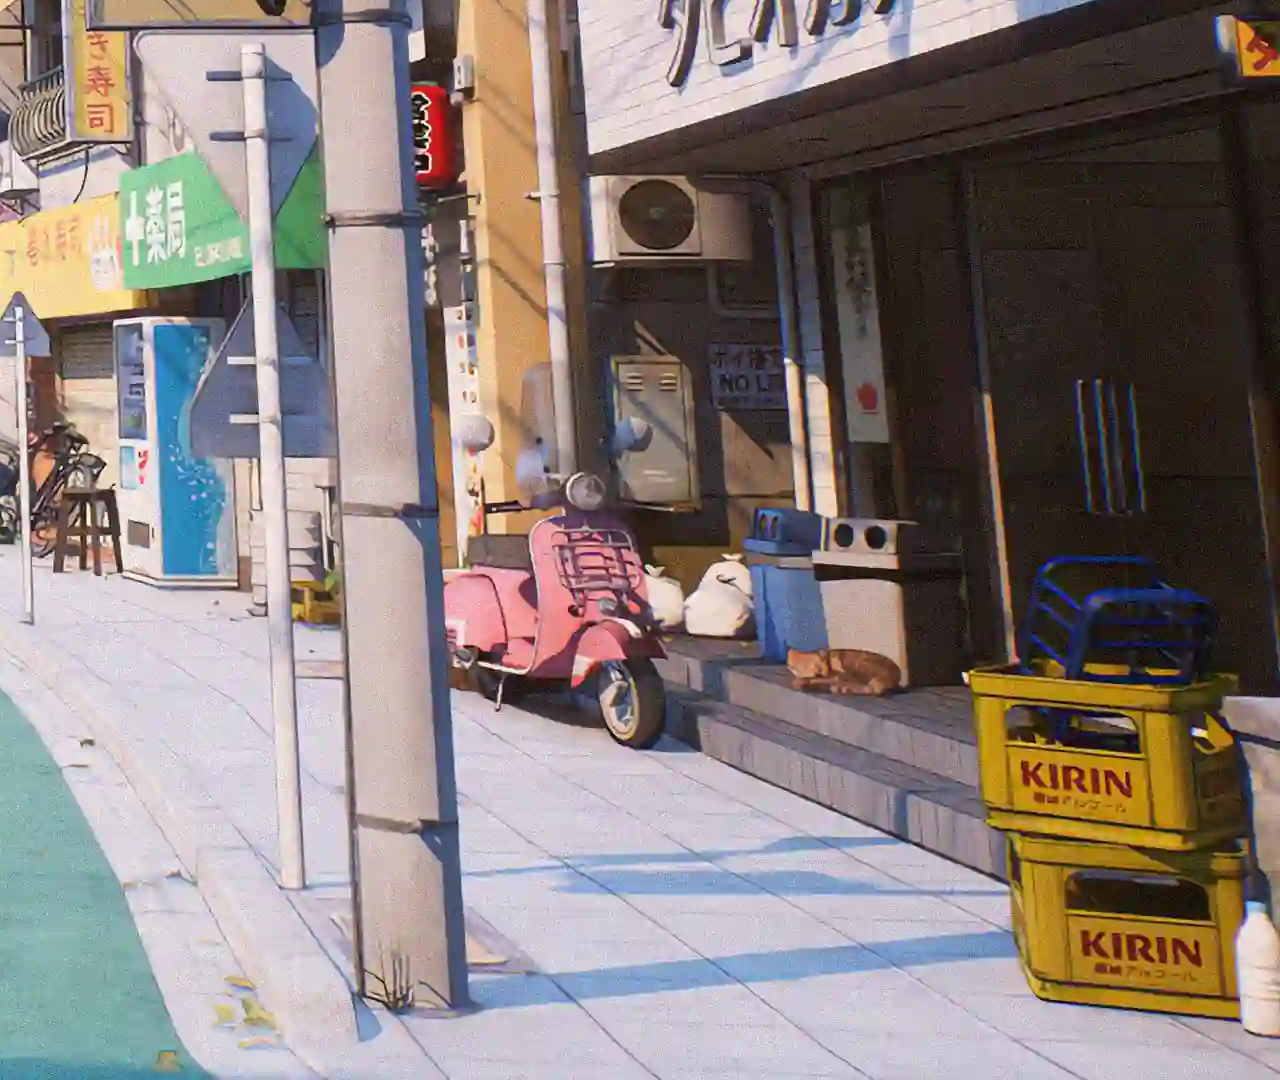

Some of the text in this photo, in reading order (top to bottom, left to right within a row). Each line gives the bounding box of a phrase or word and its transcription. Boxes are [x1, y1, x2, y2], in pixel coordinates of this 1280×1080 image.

[82, 30, 117, 133] き寿司
[145, 181, 187, 266] 薬局
[719, 373, 749, 392] NO
[1021, 759, 1133, 799] KIRIN
[1080, 930, 1203, 968] KIRIN
